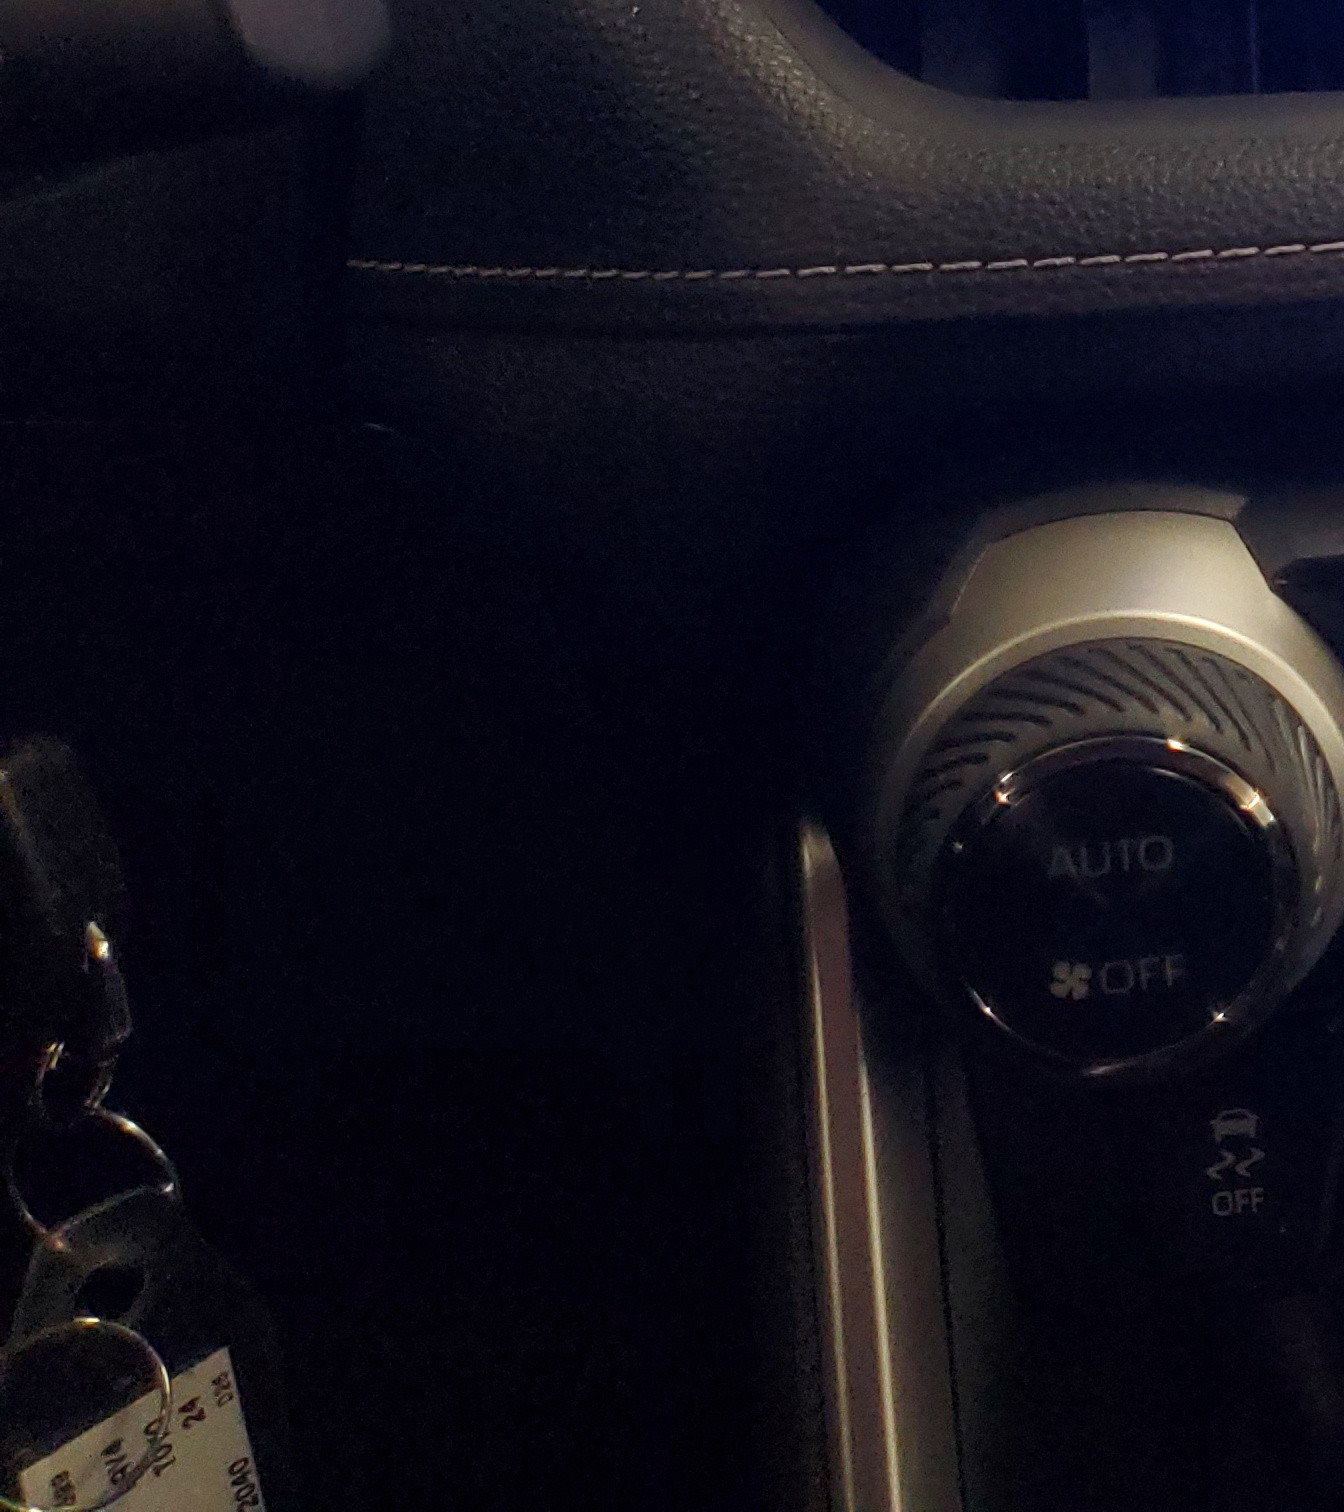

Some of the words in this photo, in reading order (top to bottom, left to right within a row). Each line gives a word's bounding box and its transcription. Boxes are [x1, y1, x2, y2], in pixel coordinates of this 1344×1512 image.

[1049, 835, 1174, 880] AUTO
[1101, 953, 1184, 994] OFF
[1212, 1188, 1264, 1216] OFF
